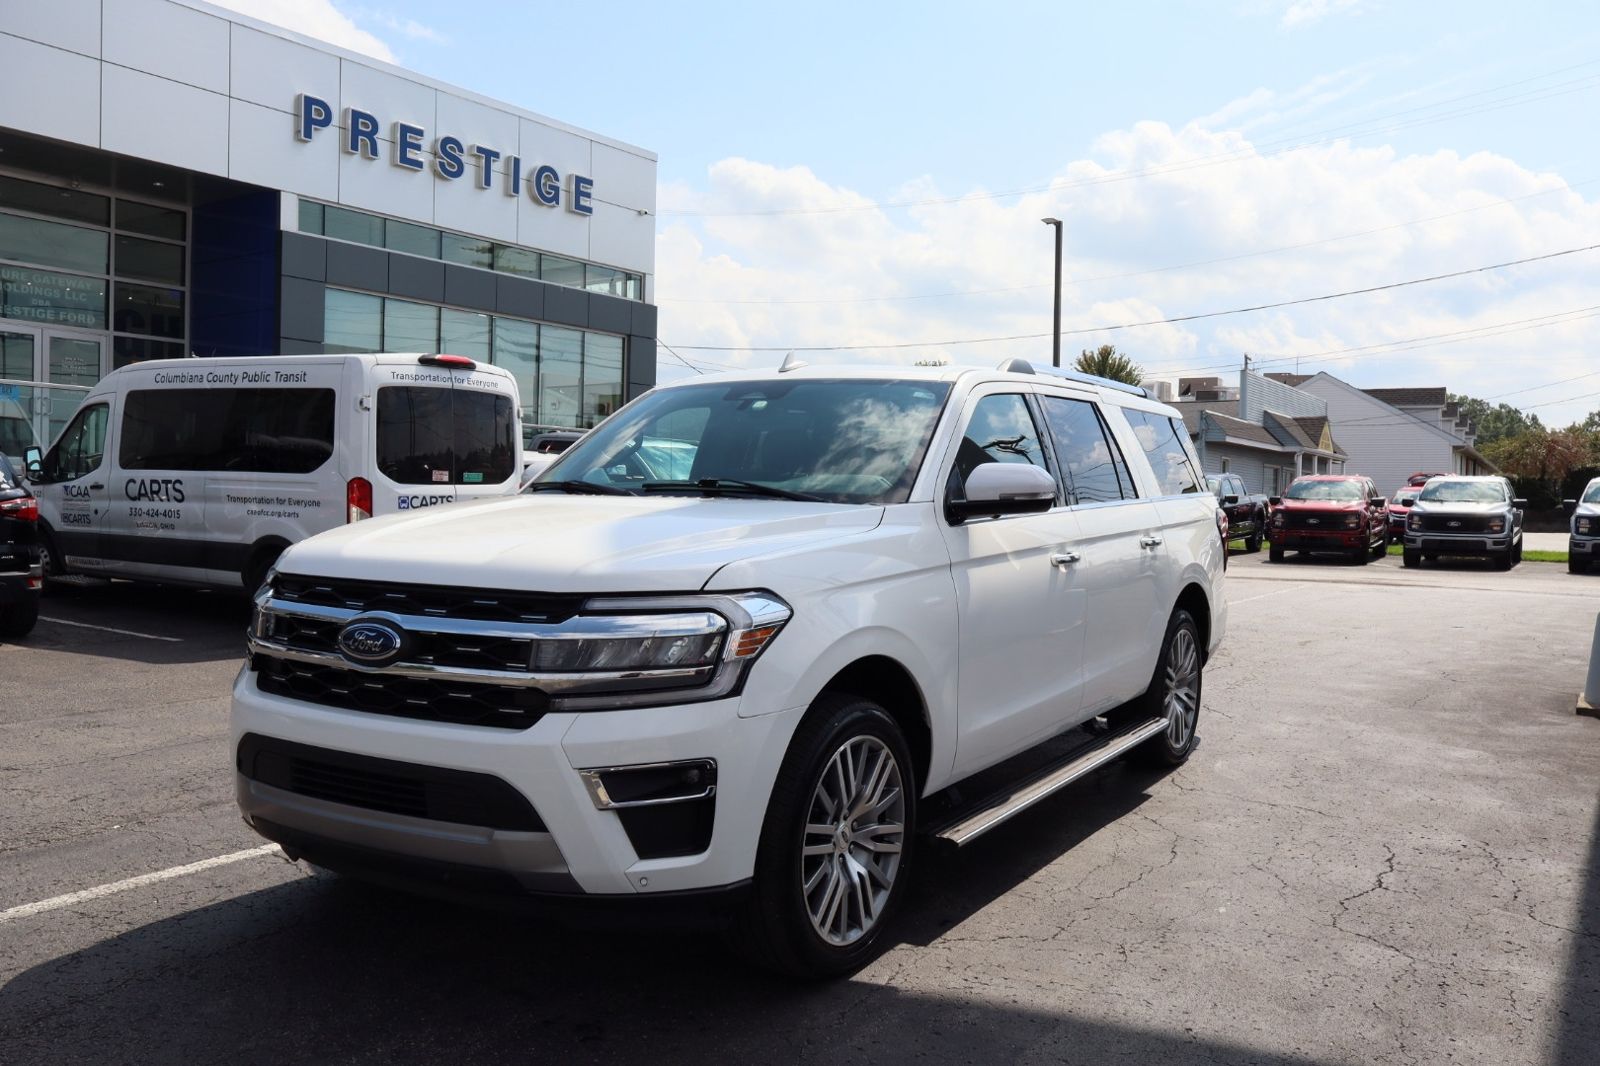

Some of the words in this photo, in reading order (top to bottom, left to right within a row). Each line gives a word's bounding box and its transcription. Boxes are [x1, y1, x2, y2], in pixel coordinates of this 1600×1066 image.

[297, 92, 594, 216] PRESTIGE
[33, 274, 91, 290] GATEWAY
[65, 290, 87, 301] LLC
[59, 311, 96, 325] FORD
[154, 372, 204, 384] Columbiana
[206, 371, 239, 385] County
[241, 371, 271, 383] Public
[274, 370, 307, 383] Transit
[391, 371, 451, 384] Transportation
[454, 375, 465, 384] for
[467, 378, 499, 389] Everyone
[71, 485, 90, 498] CAA
[126, 479, 185, 503] CARTS
[226, 494, 275, 505] Transportation
[276, 496, 287, 505] for
[288, 497, 321, 508] Everyone
[410, 494, 454, 509] CARTS
[69, 513, 91, 524] CARTS
[128, 507, 181, 519] 330-424-4015
[351, 630, 384, 651] Ford
